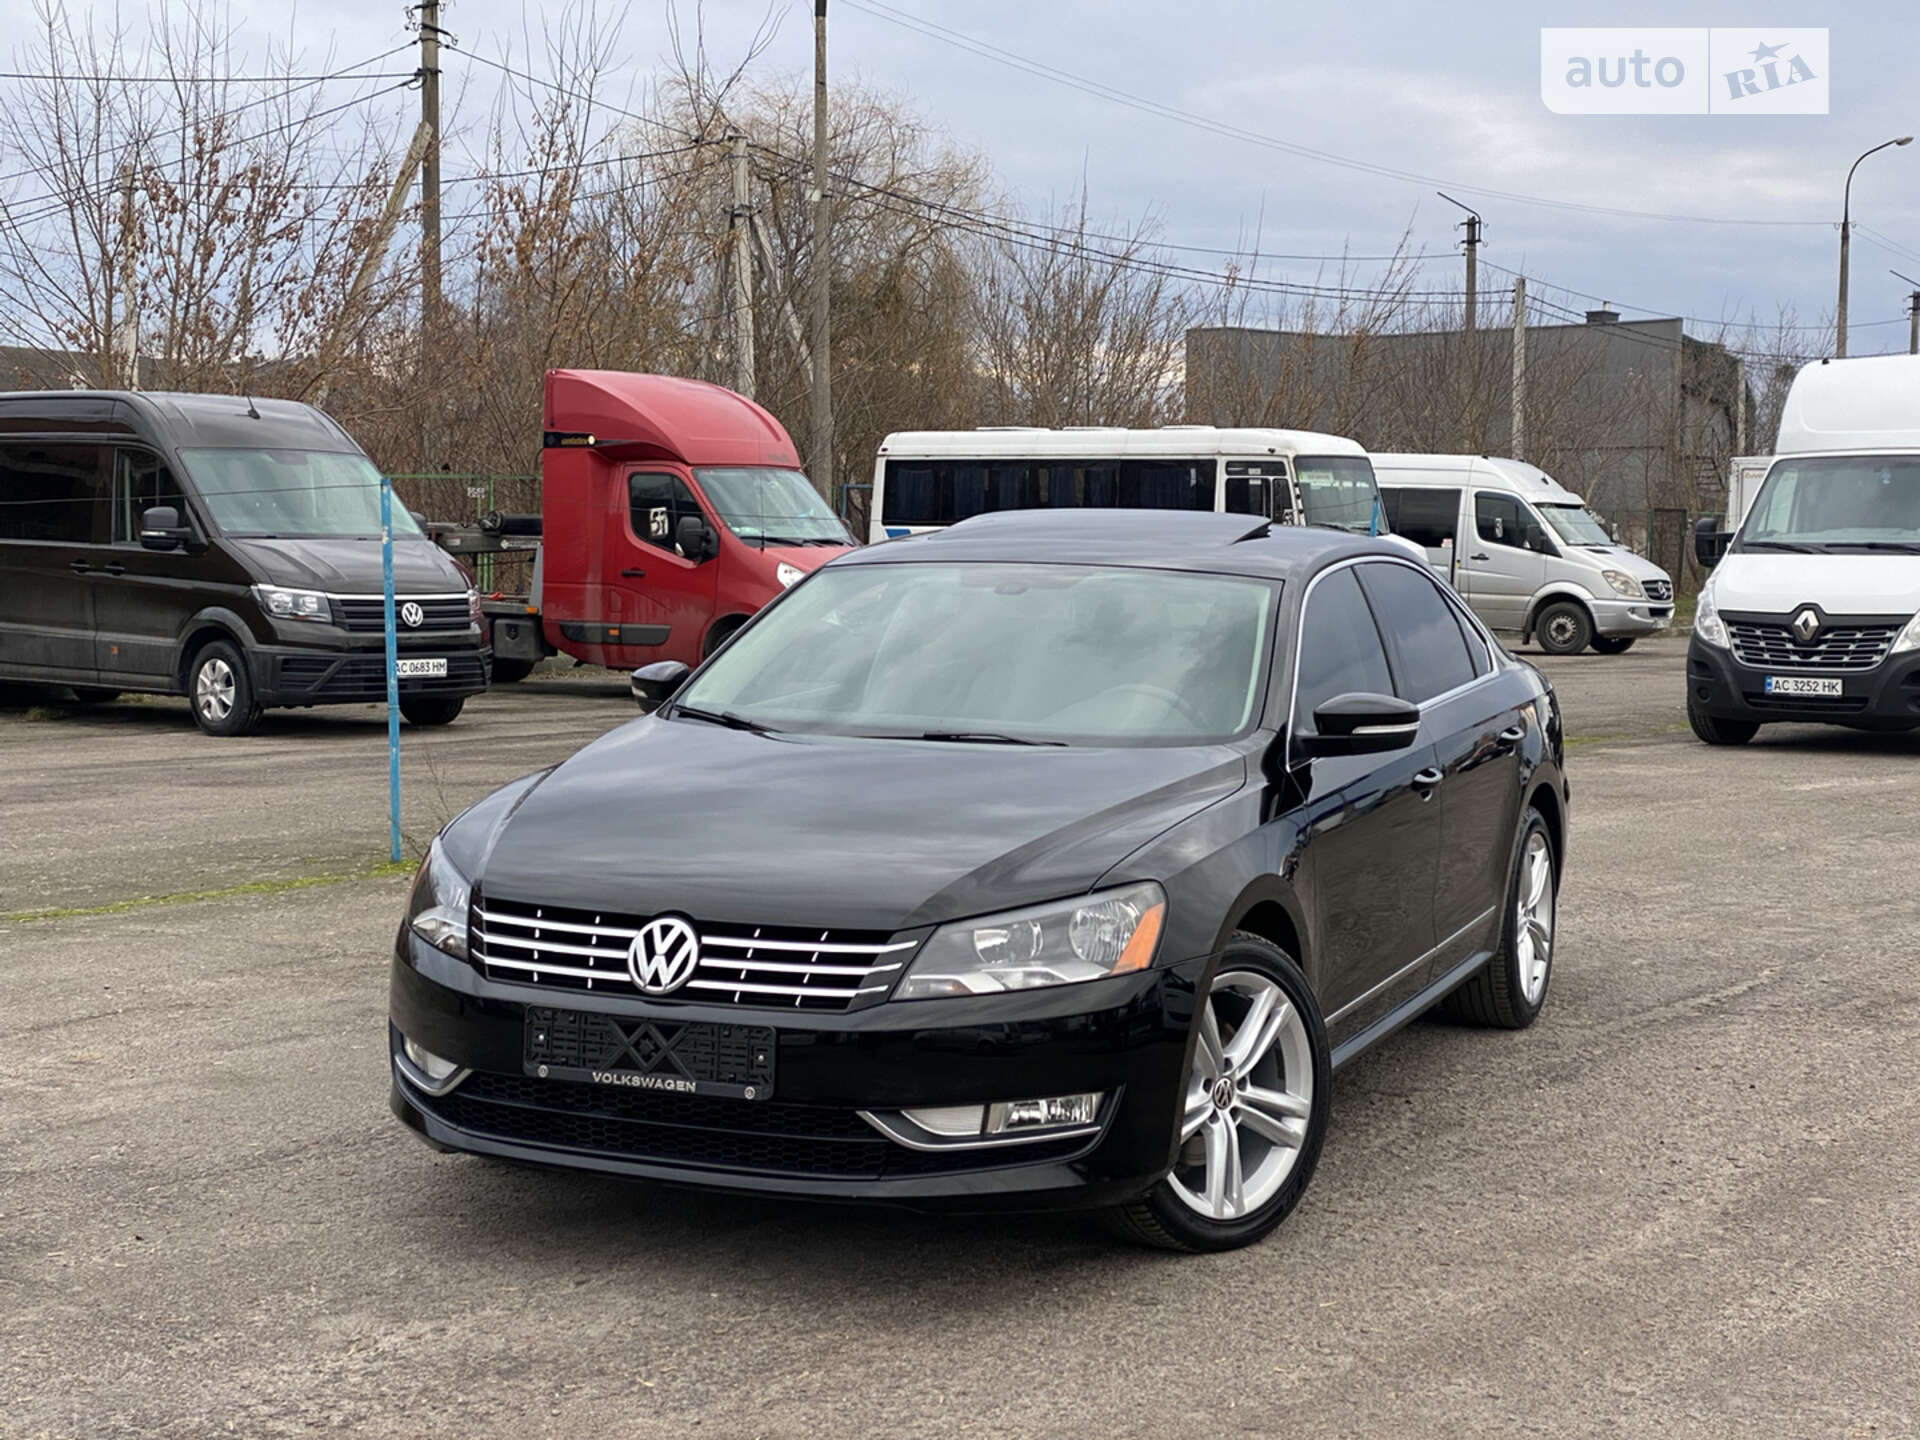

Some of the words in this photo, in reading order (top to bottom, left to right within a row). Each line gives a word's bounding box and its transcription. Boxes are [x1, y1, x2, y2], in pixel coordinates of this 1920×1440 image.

[1774, 679, 1790, 692] AC
[1793, 680, 1820, 693] 3252
[1822, 681, 1840, 694] HK
[592, 1071, 696, 1093] VOLKSWAGEN
